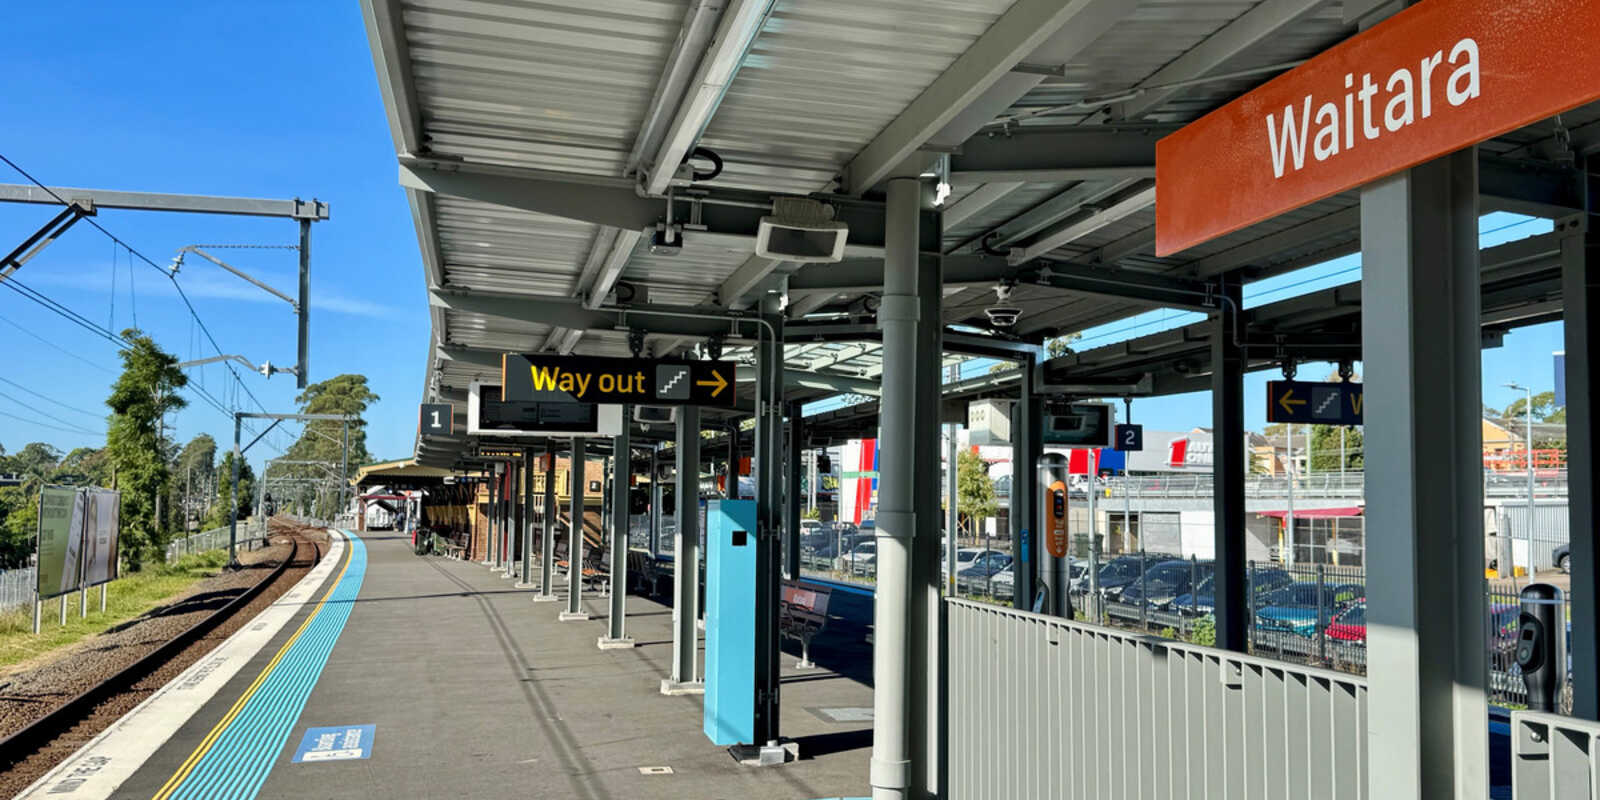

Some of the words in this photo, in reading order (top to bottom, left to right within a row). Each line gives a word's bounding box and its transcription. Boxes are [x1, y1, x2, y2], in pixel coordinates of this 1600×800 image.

[1266, 38, 1480, 179] Waitara
[530, 365, 592, 398] Way
[598, 371, 646, 393] out
[431, 411, 441, 428] 1
[1125, 430, 1135, 445] 2
[1186, 440, 1213, 453] AUT
